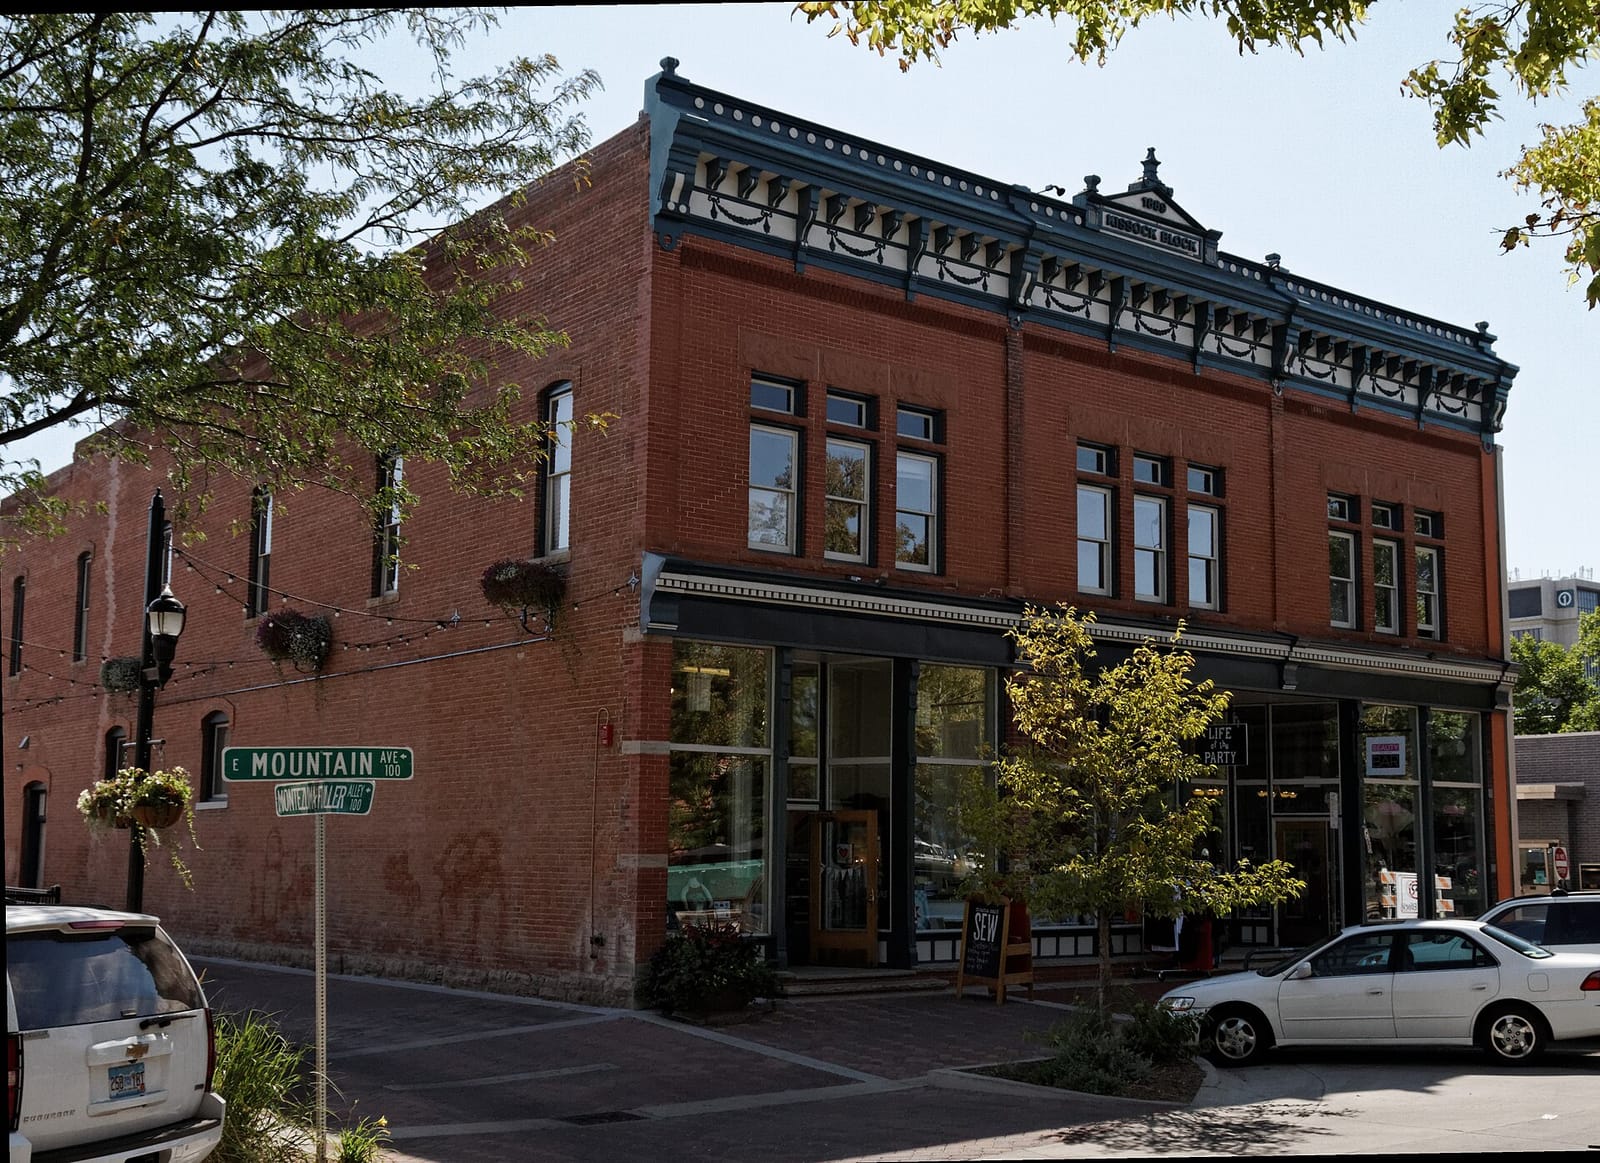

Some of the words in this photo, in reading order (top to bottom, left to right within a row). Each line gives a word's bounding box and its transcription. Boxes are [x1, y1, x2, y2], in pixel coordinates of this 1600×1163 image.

[1160, 231, 1197, 252] BLOCK
[1208, 727, 1232, 740] LIFE
[232, 758, 239, 771] E
[251, 752, 373, 777] MOUNTAIN
[380, 751, 398, 764] AVE
[1204, 751, 1237, 764] PARTY
[384, 764, 401, 777] 100
[347, 784, 365, 798] ALLEY
[350, 799, 362, 811] 100
[973, 912, 999, 943] SEW
